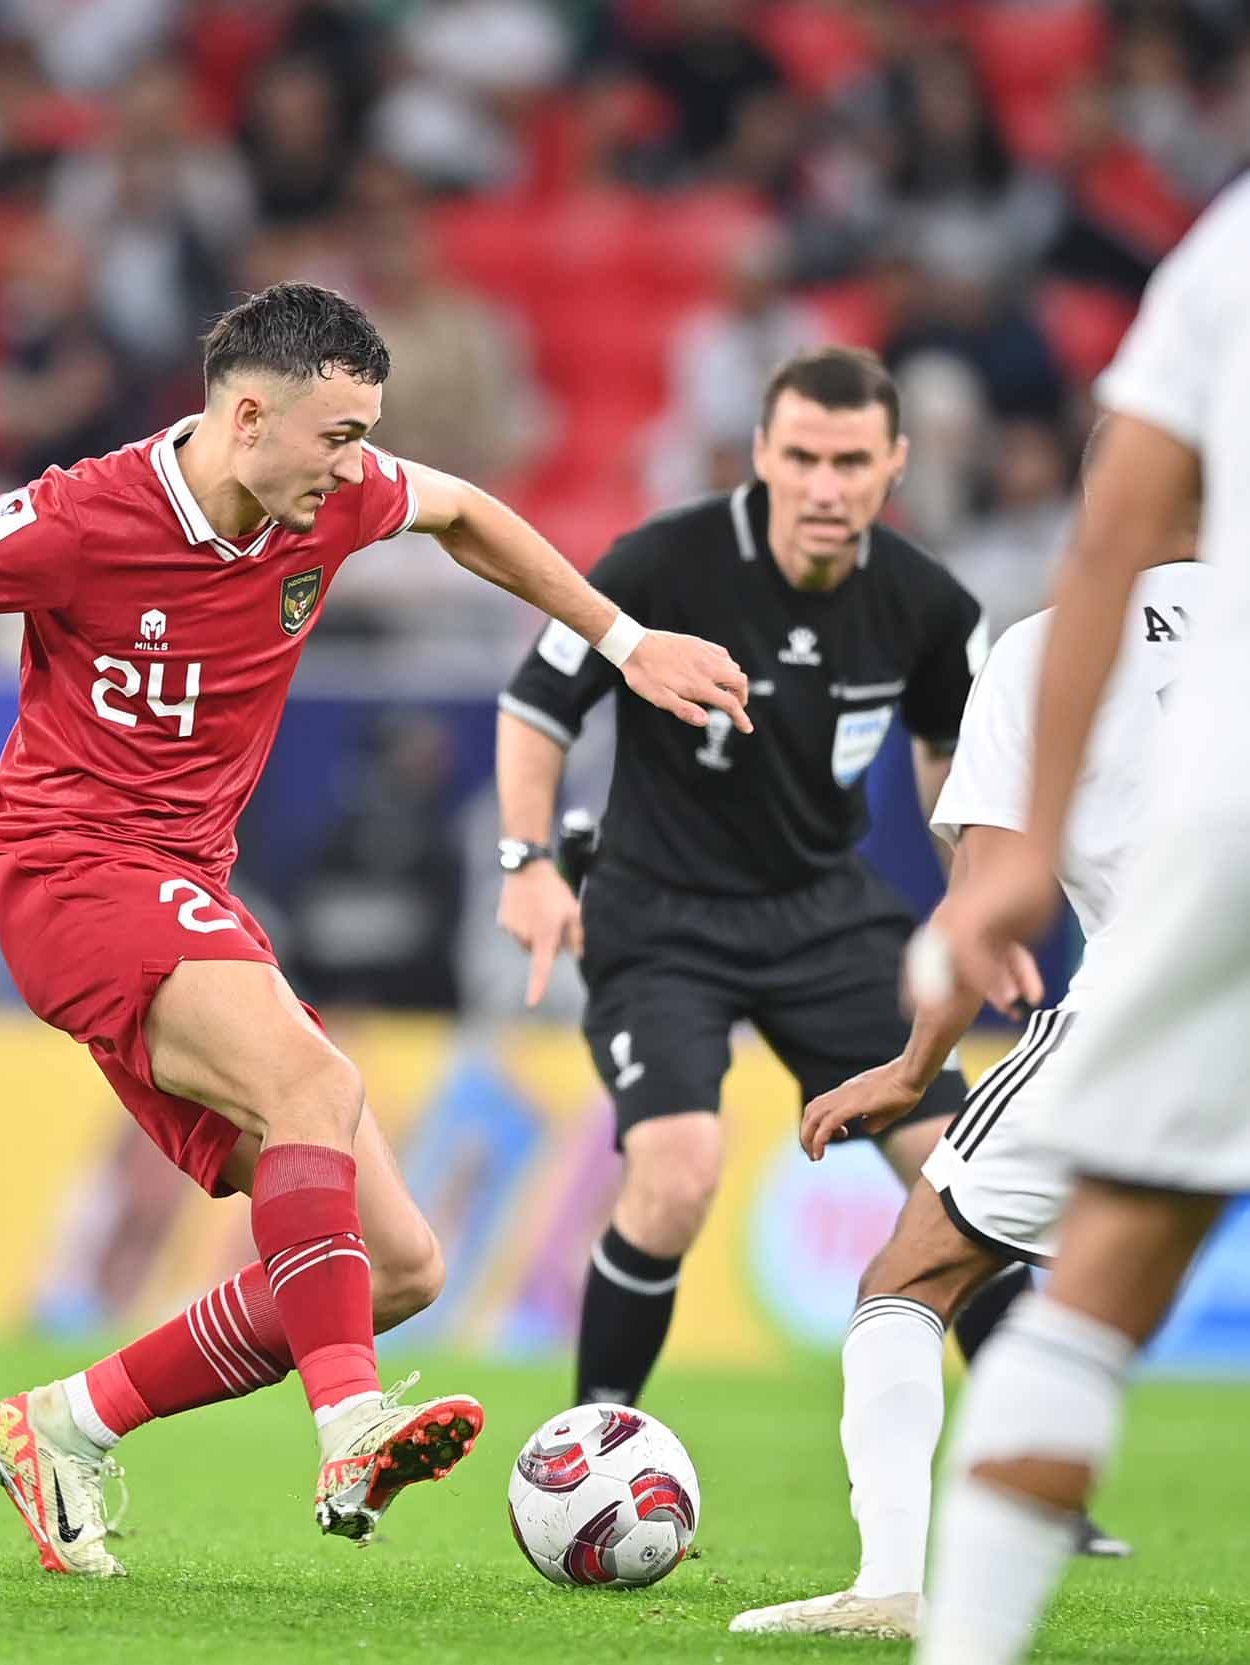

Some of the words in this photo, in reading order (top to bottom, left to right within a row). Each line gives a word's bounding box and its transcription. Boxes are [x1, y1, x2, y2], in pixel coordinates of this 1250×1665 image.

[134, 641, 169, 651] MILLS
[91, 655, 201, 738] 24
[159, 878, 239, 935] 2
